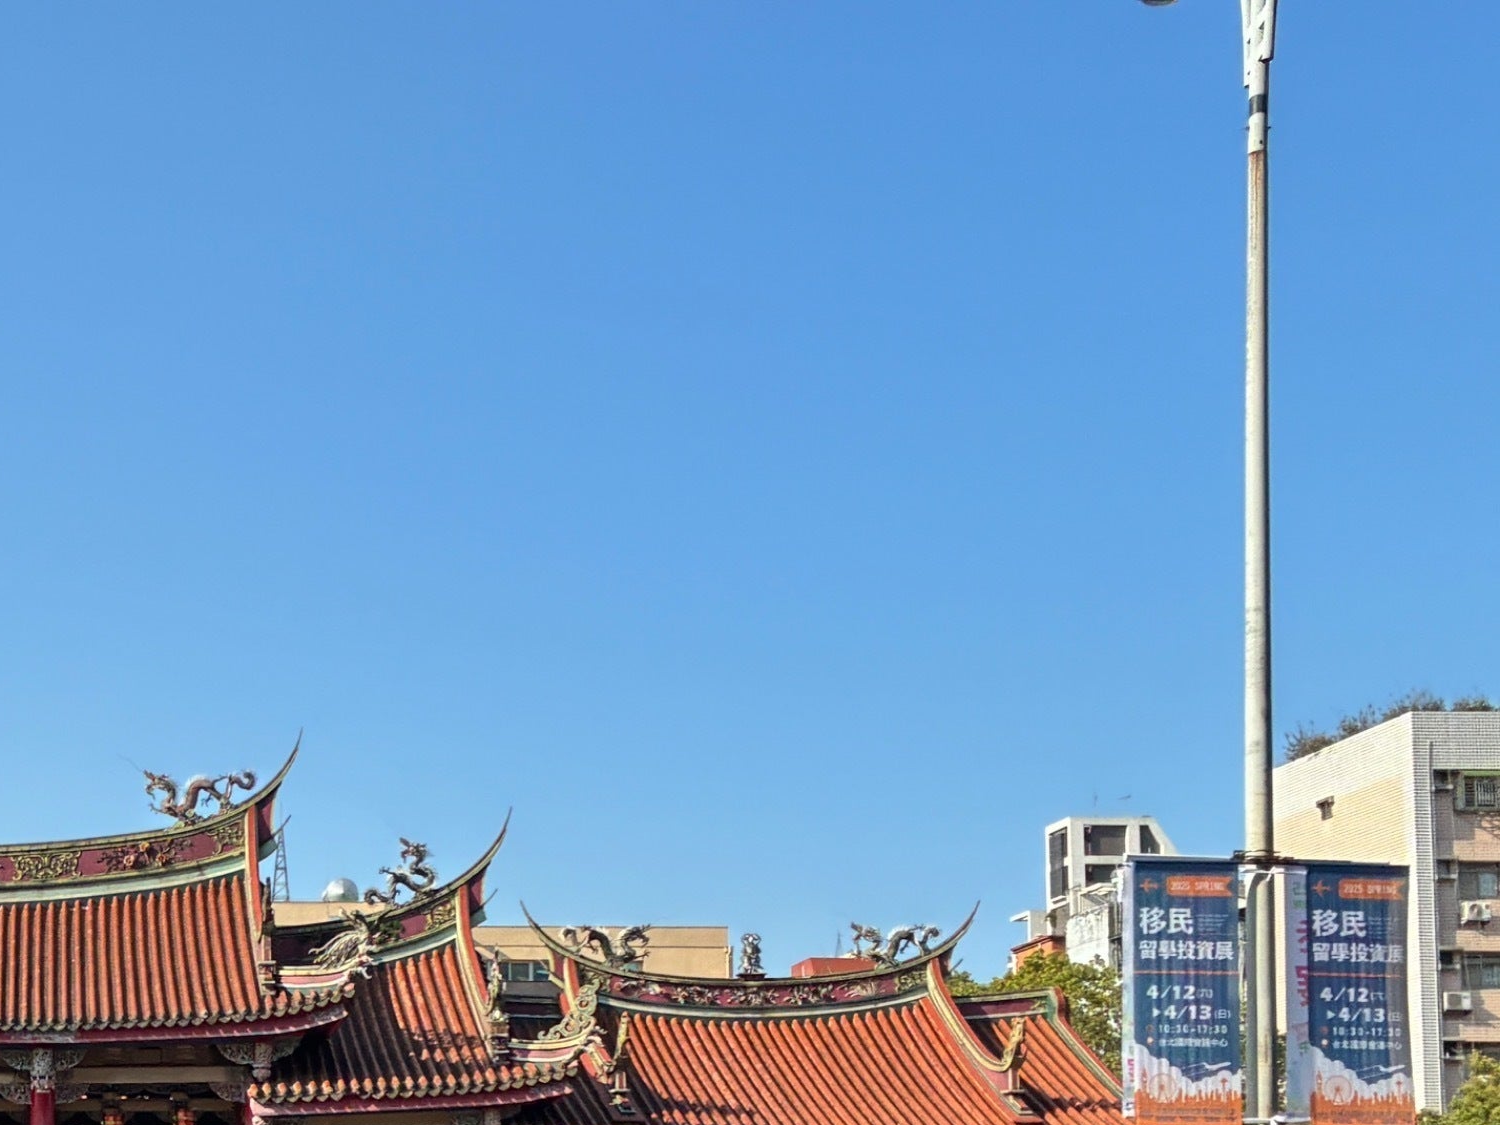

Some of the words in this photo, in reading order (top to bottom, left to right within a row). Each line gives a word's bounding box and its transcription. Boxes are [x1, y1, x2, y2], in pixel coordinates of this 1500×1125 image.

[1139, 907, 1194, 935] 移民
[1312, 909, 1367, 937] 移民
[1139, 940, 1234, 960] 留學投資展
